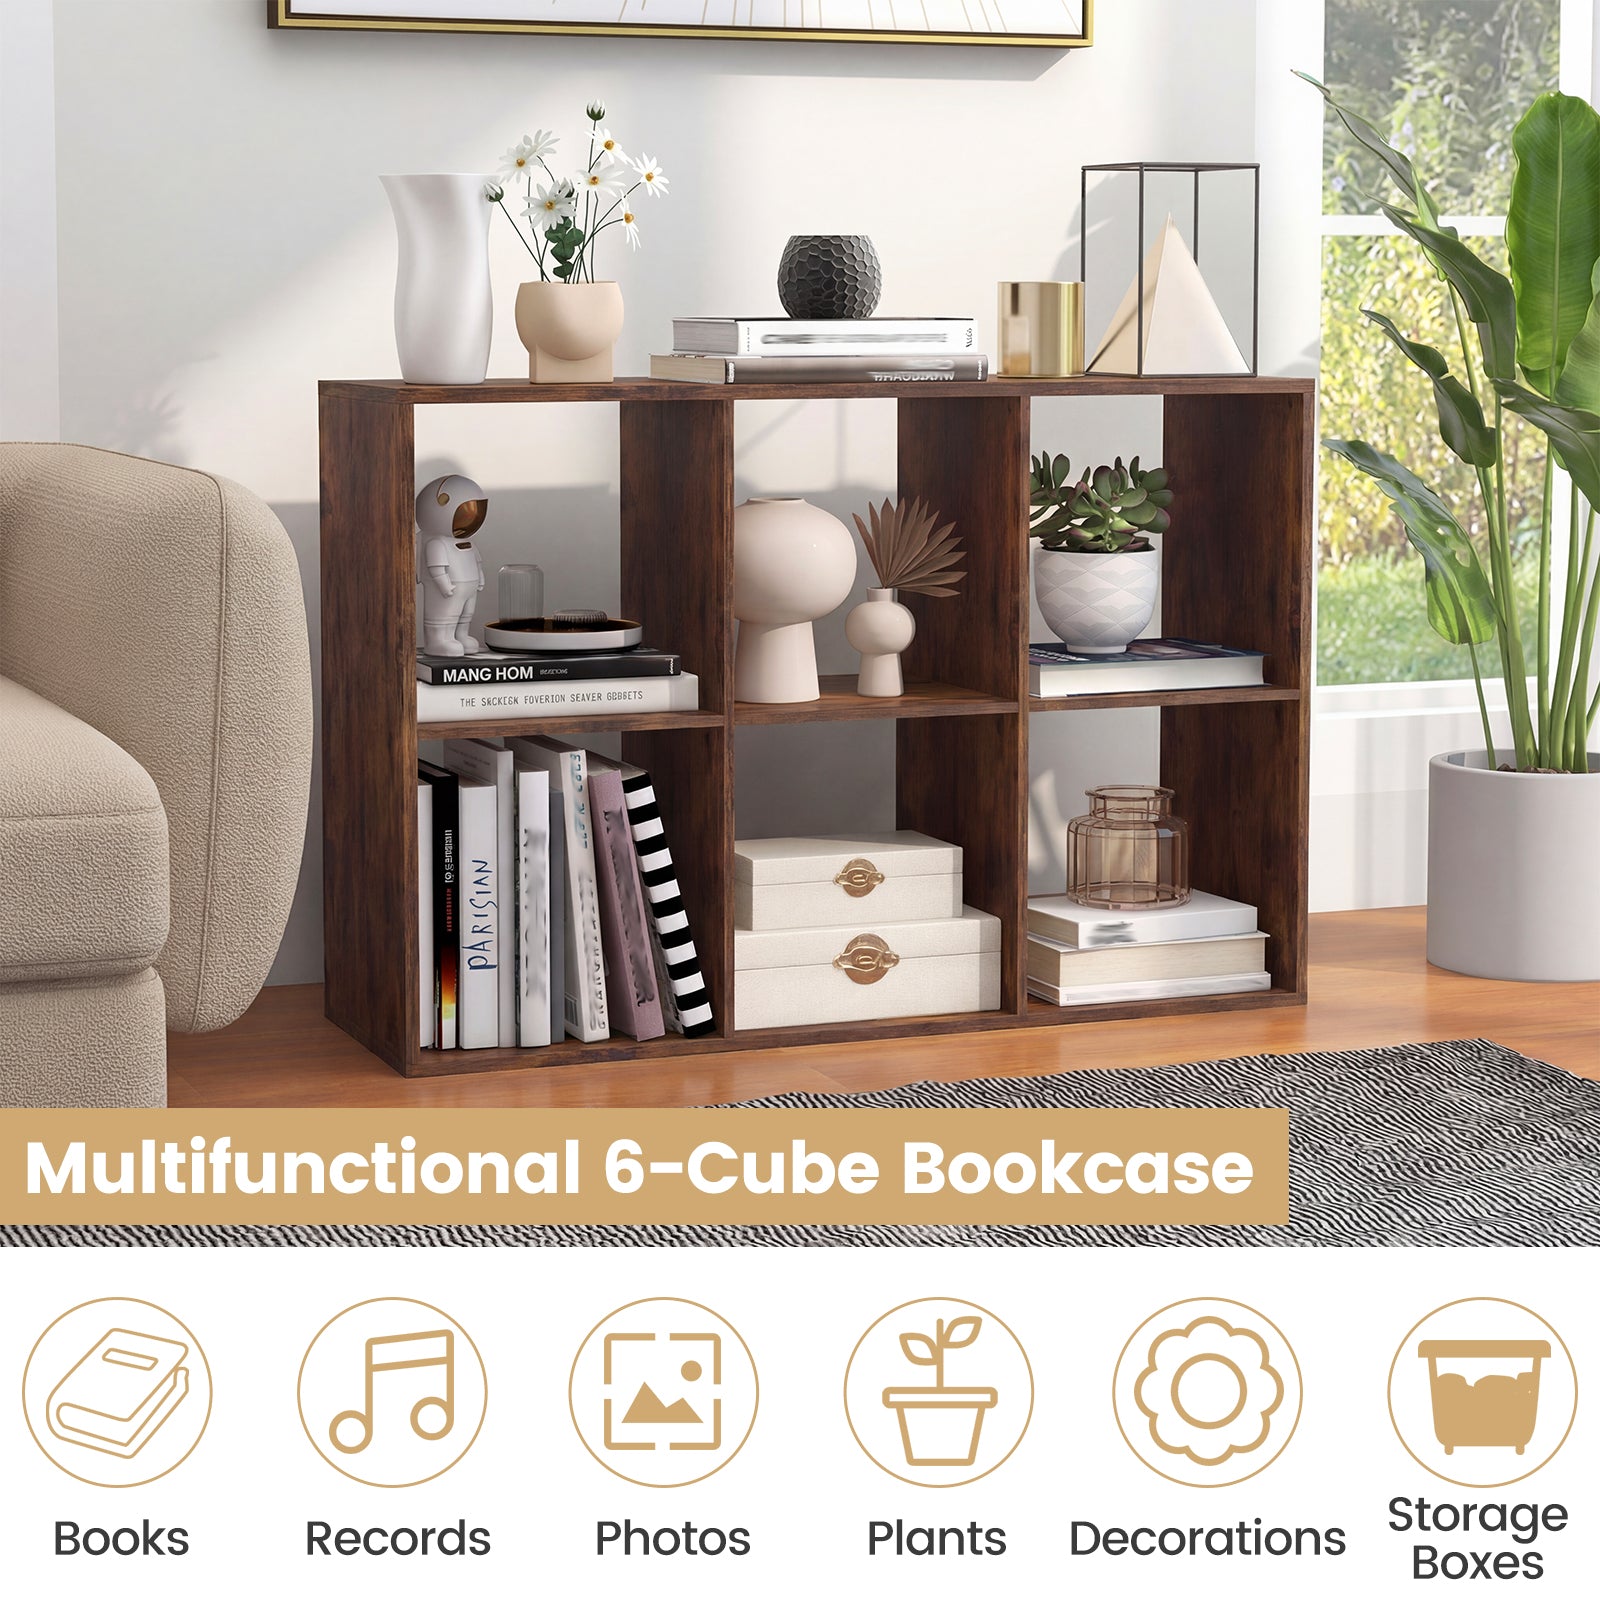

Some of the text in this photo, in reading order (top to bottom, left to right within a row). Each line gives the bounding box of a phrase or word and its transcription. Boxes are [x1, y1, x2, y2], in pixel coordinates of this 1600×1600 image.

[443, 668, 492, 682] MANG
[495, 666, 534, 680] HOM
[460, 698, 476, 707] THE
[570, 692, 603, 703] SEAVER
[462, 860, 497, 970] PARISIAN
